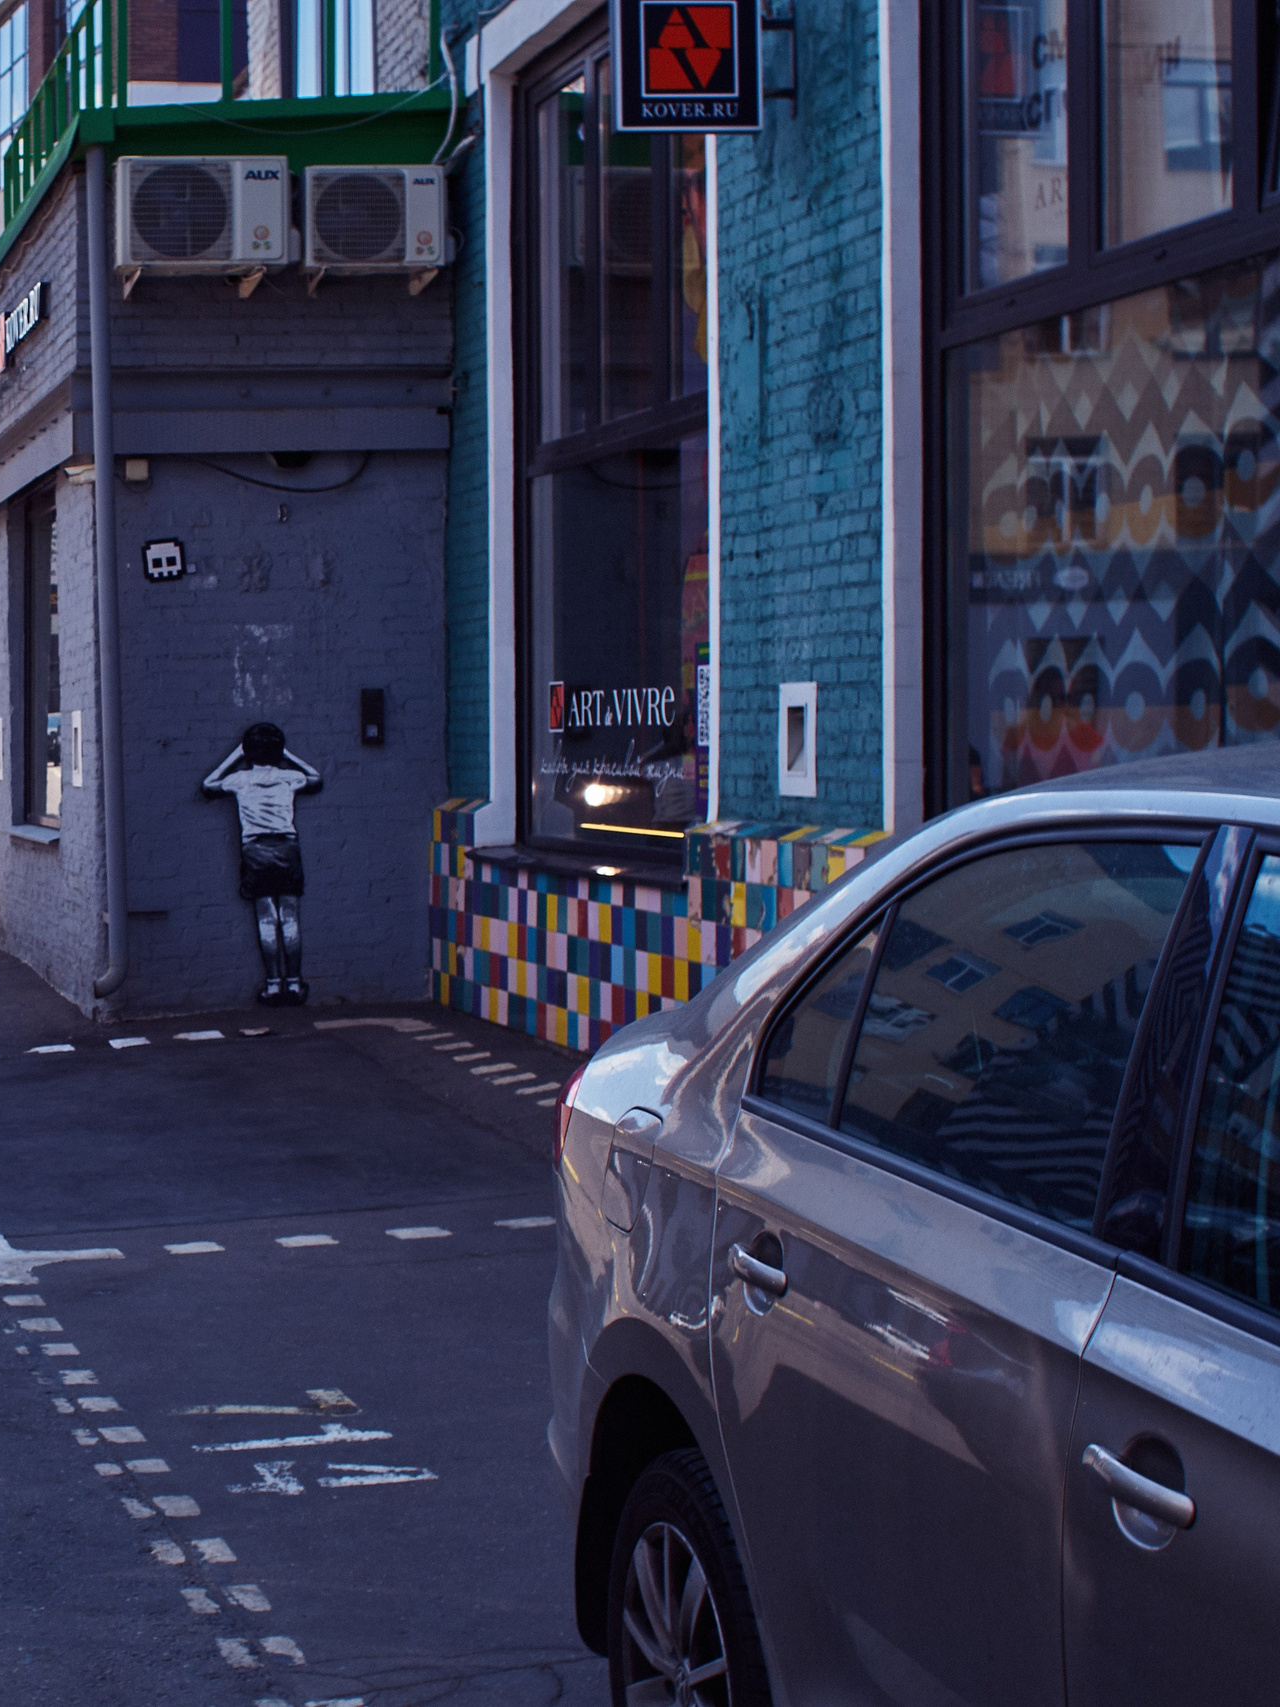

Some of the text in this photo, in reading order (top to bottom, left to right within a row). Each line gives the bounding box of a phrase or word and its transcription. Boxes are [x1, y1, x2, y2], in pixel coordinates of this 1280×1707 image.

[641, 102, 739, 118] KOVER.RU
[245, 169, 280, 181] AUX
[413, 177, 435, 186] AUX
[569, 690, 604, 727] ART
